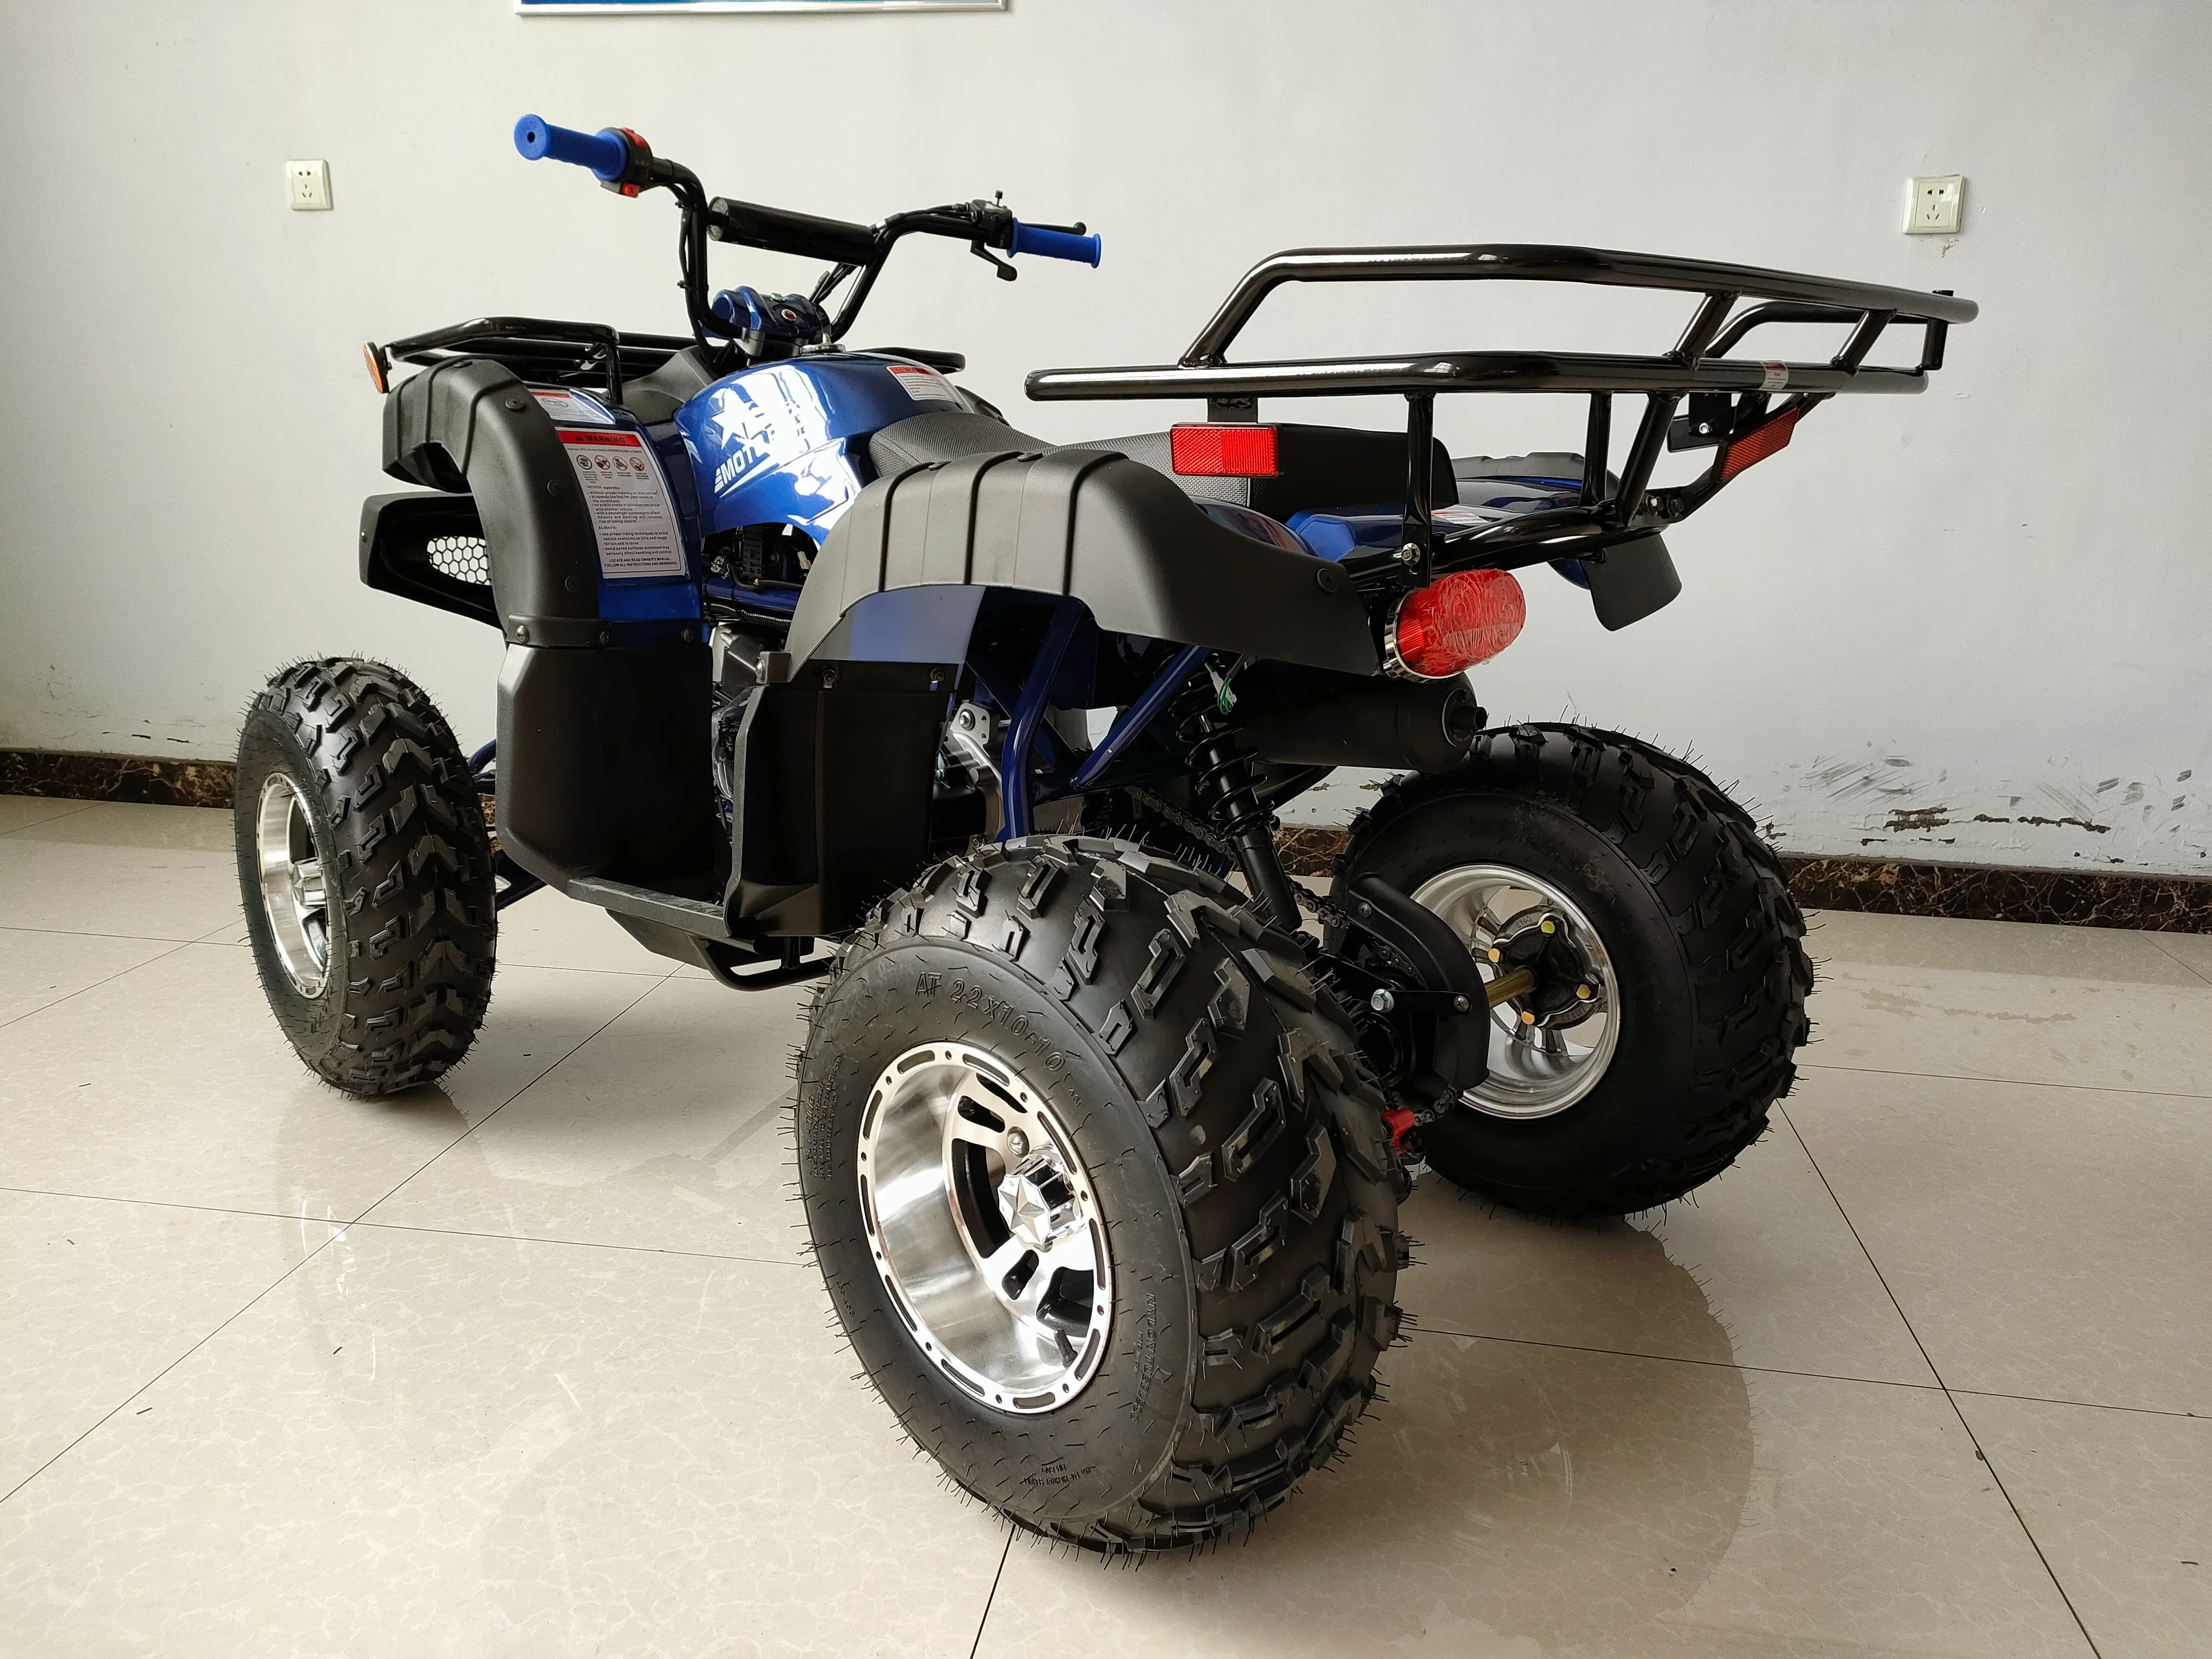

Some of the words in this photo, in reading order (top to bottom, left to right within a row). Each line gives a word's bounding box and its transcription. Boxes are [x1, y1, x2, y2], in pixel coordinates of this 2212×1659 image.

[585, 435, 626, 443] WARNING
[915, 972, 941, 996] AT
[1147, 1293, 1155, 1353] NYLON
[1130, 1354, 1153, 1423] TUBELESS
